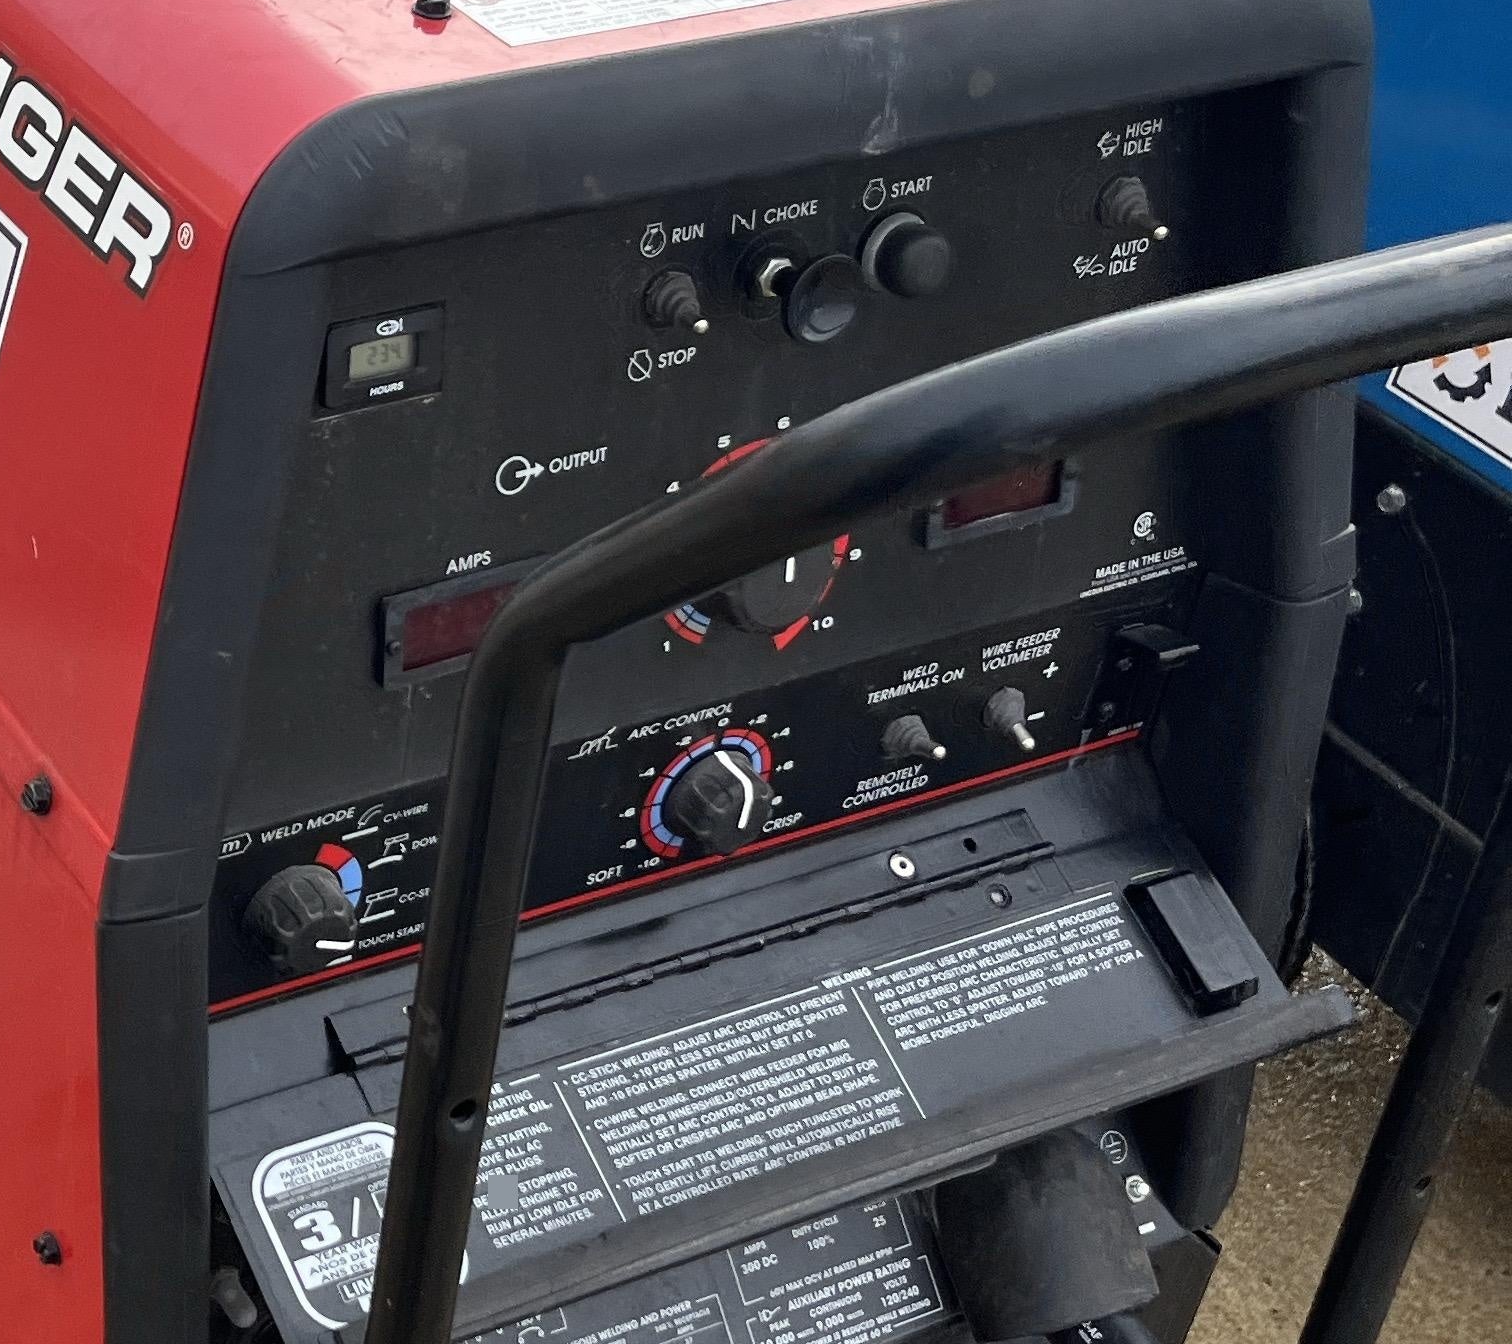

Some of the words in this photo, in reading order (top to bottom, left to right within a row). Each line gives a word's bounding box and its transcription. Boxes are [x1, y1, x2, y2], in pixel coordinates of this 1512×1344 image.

[1125, 118, 1163, 139] HIGH
[1122, 136, 1153, 157] IDLE
[890, 175, 934, 199] START
[763, 199, 819, 226] CHOKE
[671, 222, 705, 244] RUN
[1110, 237, 1150, 259] AUTO
[1108, 256, 1138, 276] IDLE
[656, 346, 698, 369] STOP
[369, 380, 405, 397] HOURS
[777, 416, 791, 431] 6
[717, 434, 732, 450] 5
[548, 446, 609, 475] OUTPUT
[665, 481, 681, 494] 4
[446, 550, 492, 576] AMPS
[848, 548, 863, 562] 9
[1095, 561, 1127, 579] MADE
[1128, 557, 1140, 571] IN
[1141, 551, 1162, 567] THE
[1163, 546, 1185, 561] USA
[811, 616, 835, 632] 10
[662, 640, 672, 654] 1
[981, 641, 1014, 660] WIRE
[1014, 627, 1062, 650] FEEDER
[981, 643, 1053, 673] VOLTMETER
[902, 662, 940, 683] WELD
[866, 674, 940, 706] TERMINALS
[941, 667, 966, 684] ON
[626, 722, 662, 742] ARC
[663, 702, 734, 732] CONTROL
[717, 716, 731, 728] 0
[856, 763, 924, 792] REMOTELY
[841, 774, 930, 809] CONTROLLED
[259, 822, 303, 844] WELD
[305, 805, 357, 831] MODE
[761, 811, 804, 834] CRISP
[410, 835, 440, 851] DOW
[585, 864, 625, 886] SOFT
[636, 856, 661, 872] -10
[398, 886, 432, 905] CC-ST
[357, 931, 396, 950] TOUCH
[396, 921, 426, 939] START
[821, 966, 871, 988] WELDING
[570, 1061, 621, 1084] CC-STICK
[672, 1031, 712, 1052] ADJUST
[713, 1024, 736, 1039] ARC
[735, 1010, 785, 1031] CONTROL
[782, 1004, 799, 1015] TO
[799, 989, 844, 1011] PREVENT
[631, 1066, 653, 1079] +10
[651, 1058, 676, 1073] FOR
[674, 1049, 703, 1066] LESS
[701, 1034, 752, 1057] STICKING
[750, 1026, 772, 1041] BUT
[772, 1017, 804, 1034] MORE
[802, 1003, 847, 1024] SPATTER
[584, 1095, 607, 1110] AND
[624, 1082, 648, 1097] FOR
[647, 1073, 676, 1089] LESS
[723, 1042, 770, 1064] INITIALLY
[770, 1035, 790, 1049] SET
[792, 1030, 804, 1042] AT
[486, 1105, 528, 1126] CHECK
[504, 1145, 525, 1159] ALL
[526, 1138, 542, 1152] AC
[518, 1186, 561, 1208] ENGINE
[560, 1181, 578, 1193] TO
[485, 1218, 511, 1234] RUN
[512, 1213, 525, 1226] AT
[526, 1204, 552, 1221] LOW
[552, 1195, 579, 1212] IDLE
[578, 1188, 603, 1203] FOR
[872, 1214, 886, 1227] 25
[492, 1224, 544, 1248] SEVERAL
[807, 1234, 834, 1250] 100%
[313, 1245, 349, 1261] YEAR
[740, 1259, 761, 1274] 300
[761, 1253, 778, 1267] DC
[788, 1283, 835, 1311] AUXILIARY
[837, 1271, 874, 1292] POWER
[874, 1257, 910, 1279] RATING
[880, 1285, 919, 1307] 120/240
